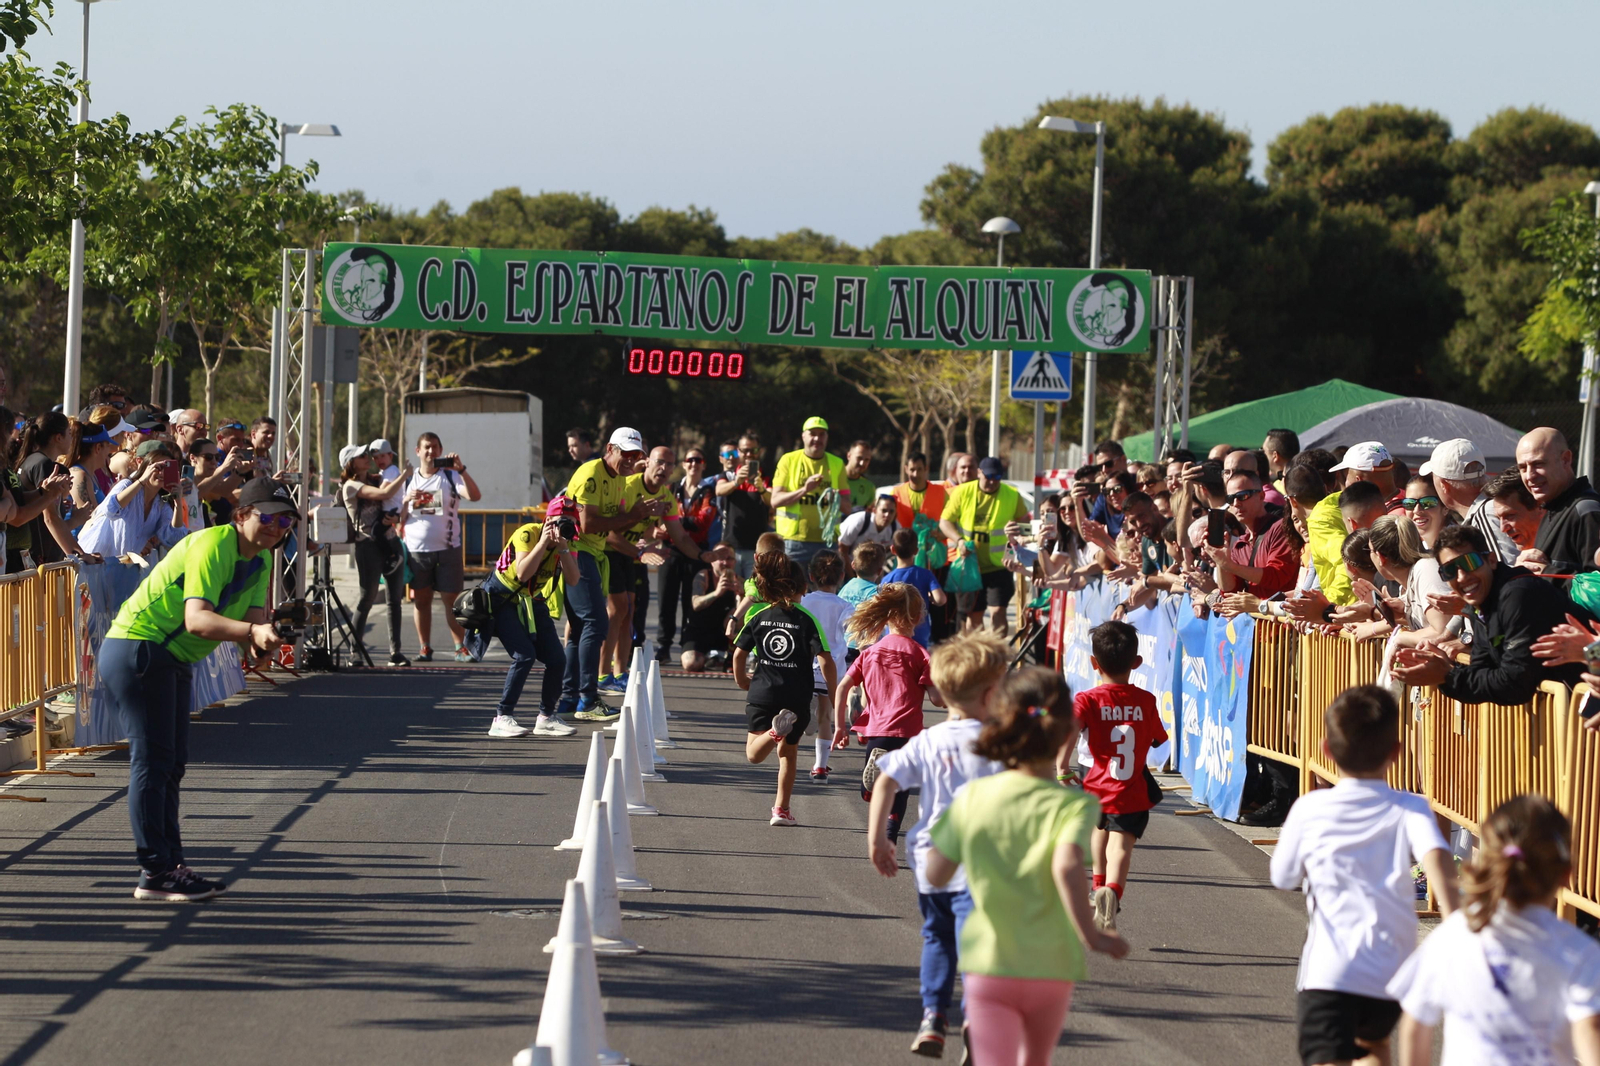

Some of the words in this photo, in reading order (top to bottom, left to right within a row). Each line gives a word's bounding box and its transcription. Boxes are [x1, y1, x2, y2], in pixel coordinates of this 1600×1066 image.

[416, 256, 488, 323] C.D.
[504, 260, 754, 334] ESPARTANOS
[767, 272, 819, 338] DE
[830, 275, 875, 340] EL
[883, 277, 1055, 348] ALQUIAN
[628, 347, 744, 379] 000000
[1100, 705, 1144, 722] RAFA
[1109, 724, 1136, 781] 3
